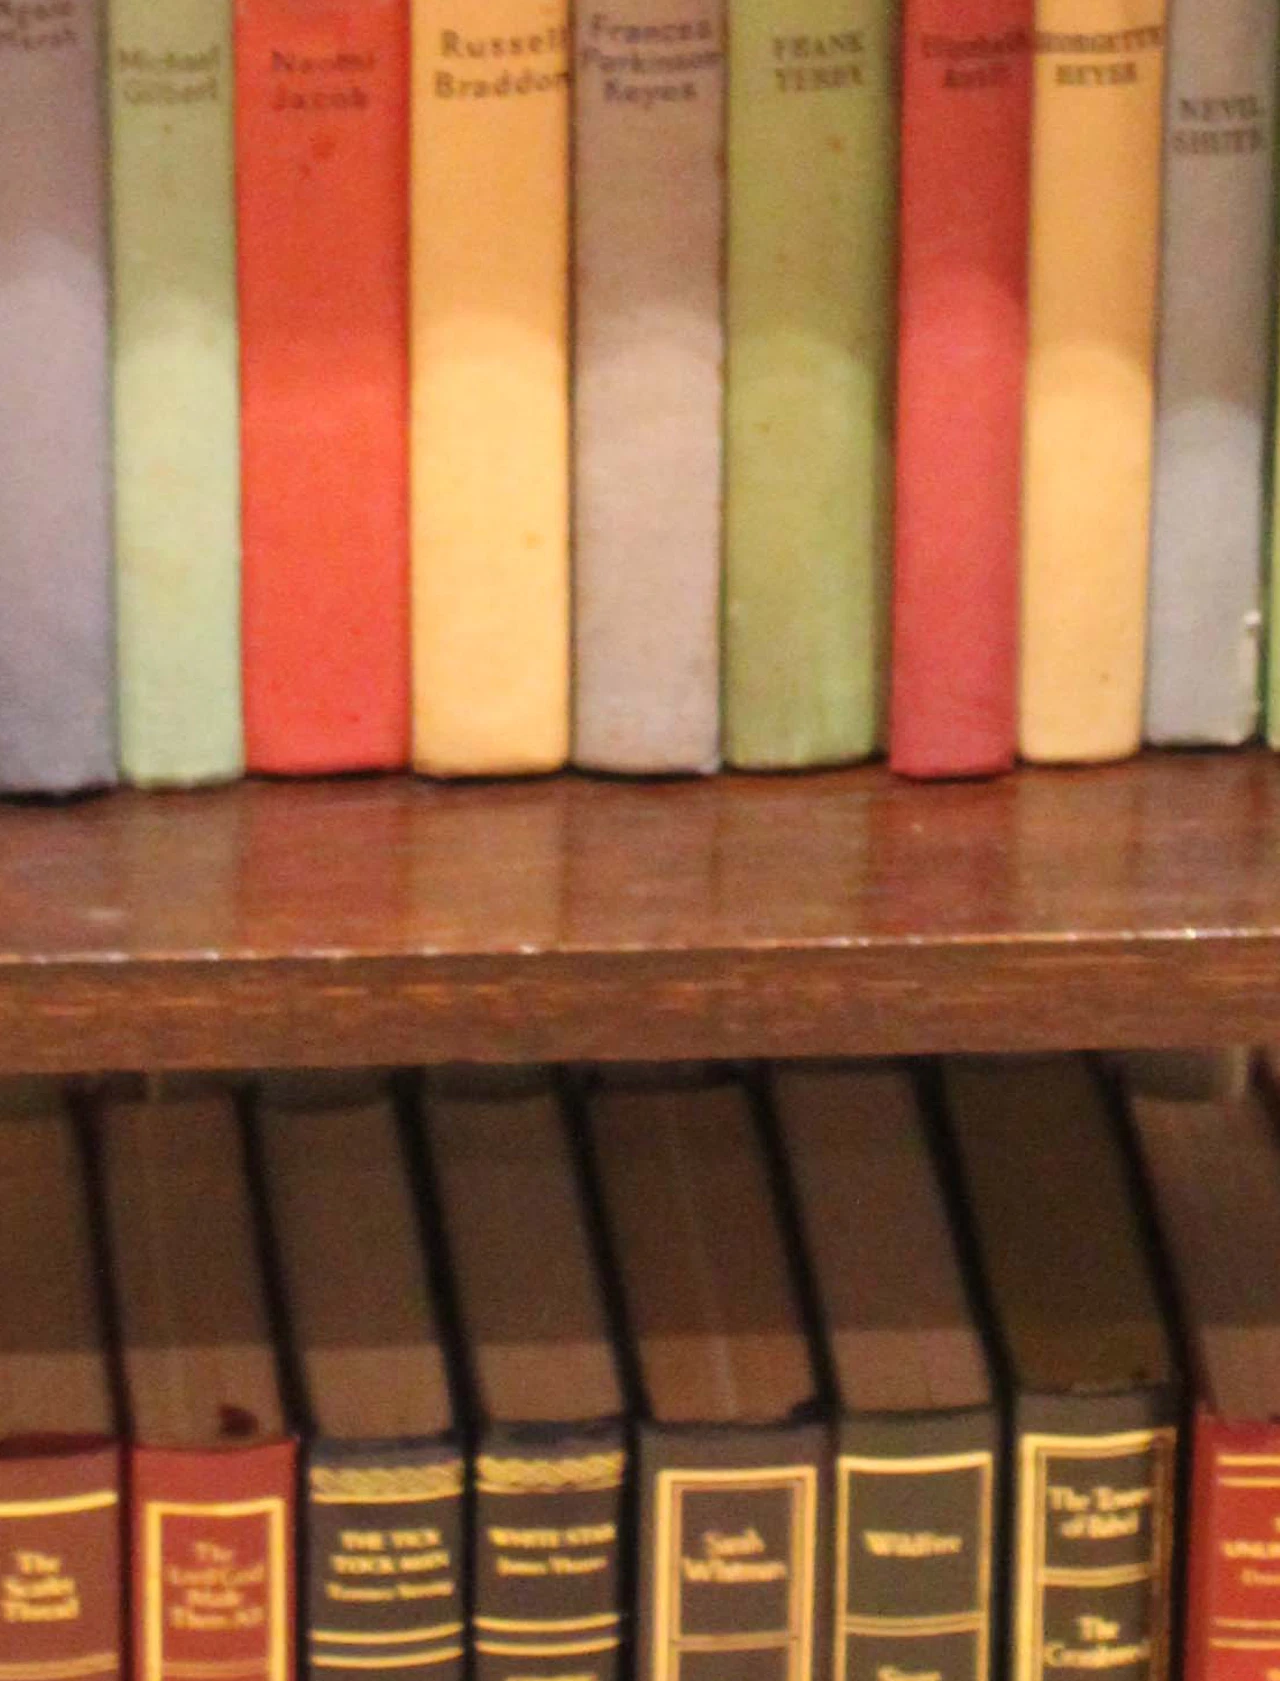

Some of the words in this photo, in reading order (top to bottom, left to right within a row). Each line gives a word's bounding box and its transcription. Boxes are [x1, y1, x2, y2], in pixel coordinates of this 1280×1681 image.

[440, 26, 571, 60] Russell
[434, 68, 571, 100] Braddon
[1048, 1487, 1091, 1511] The
